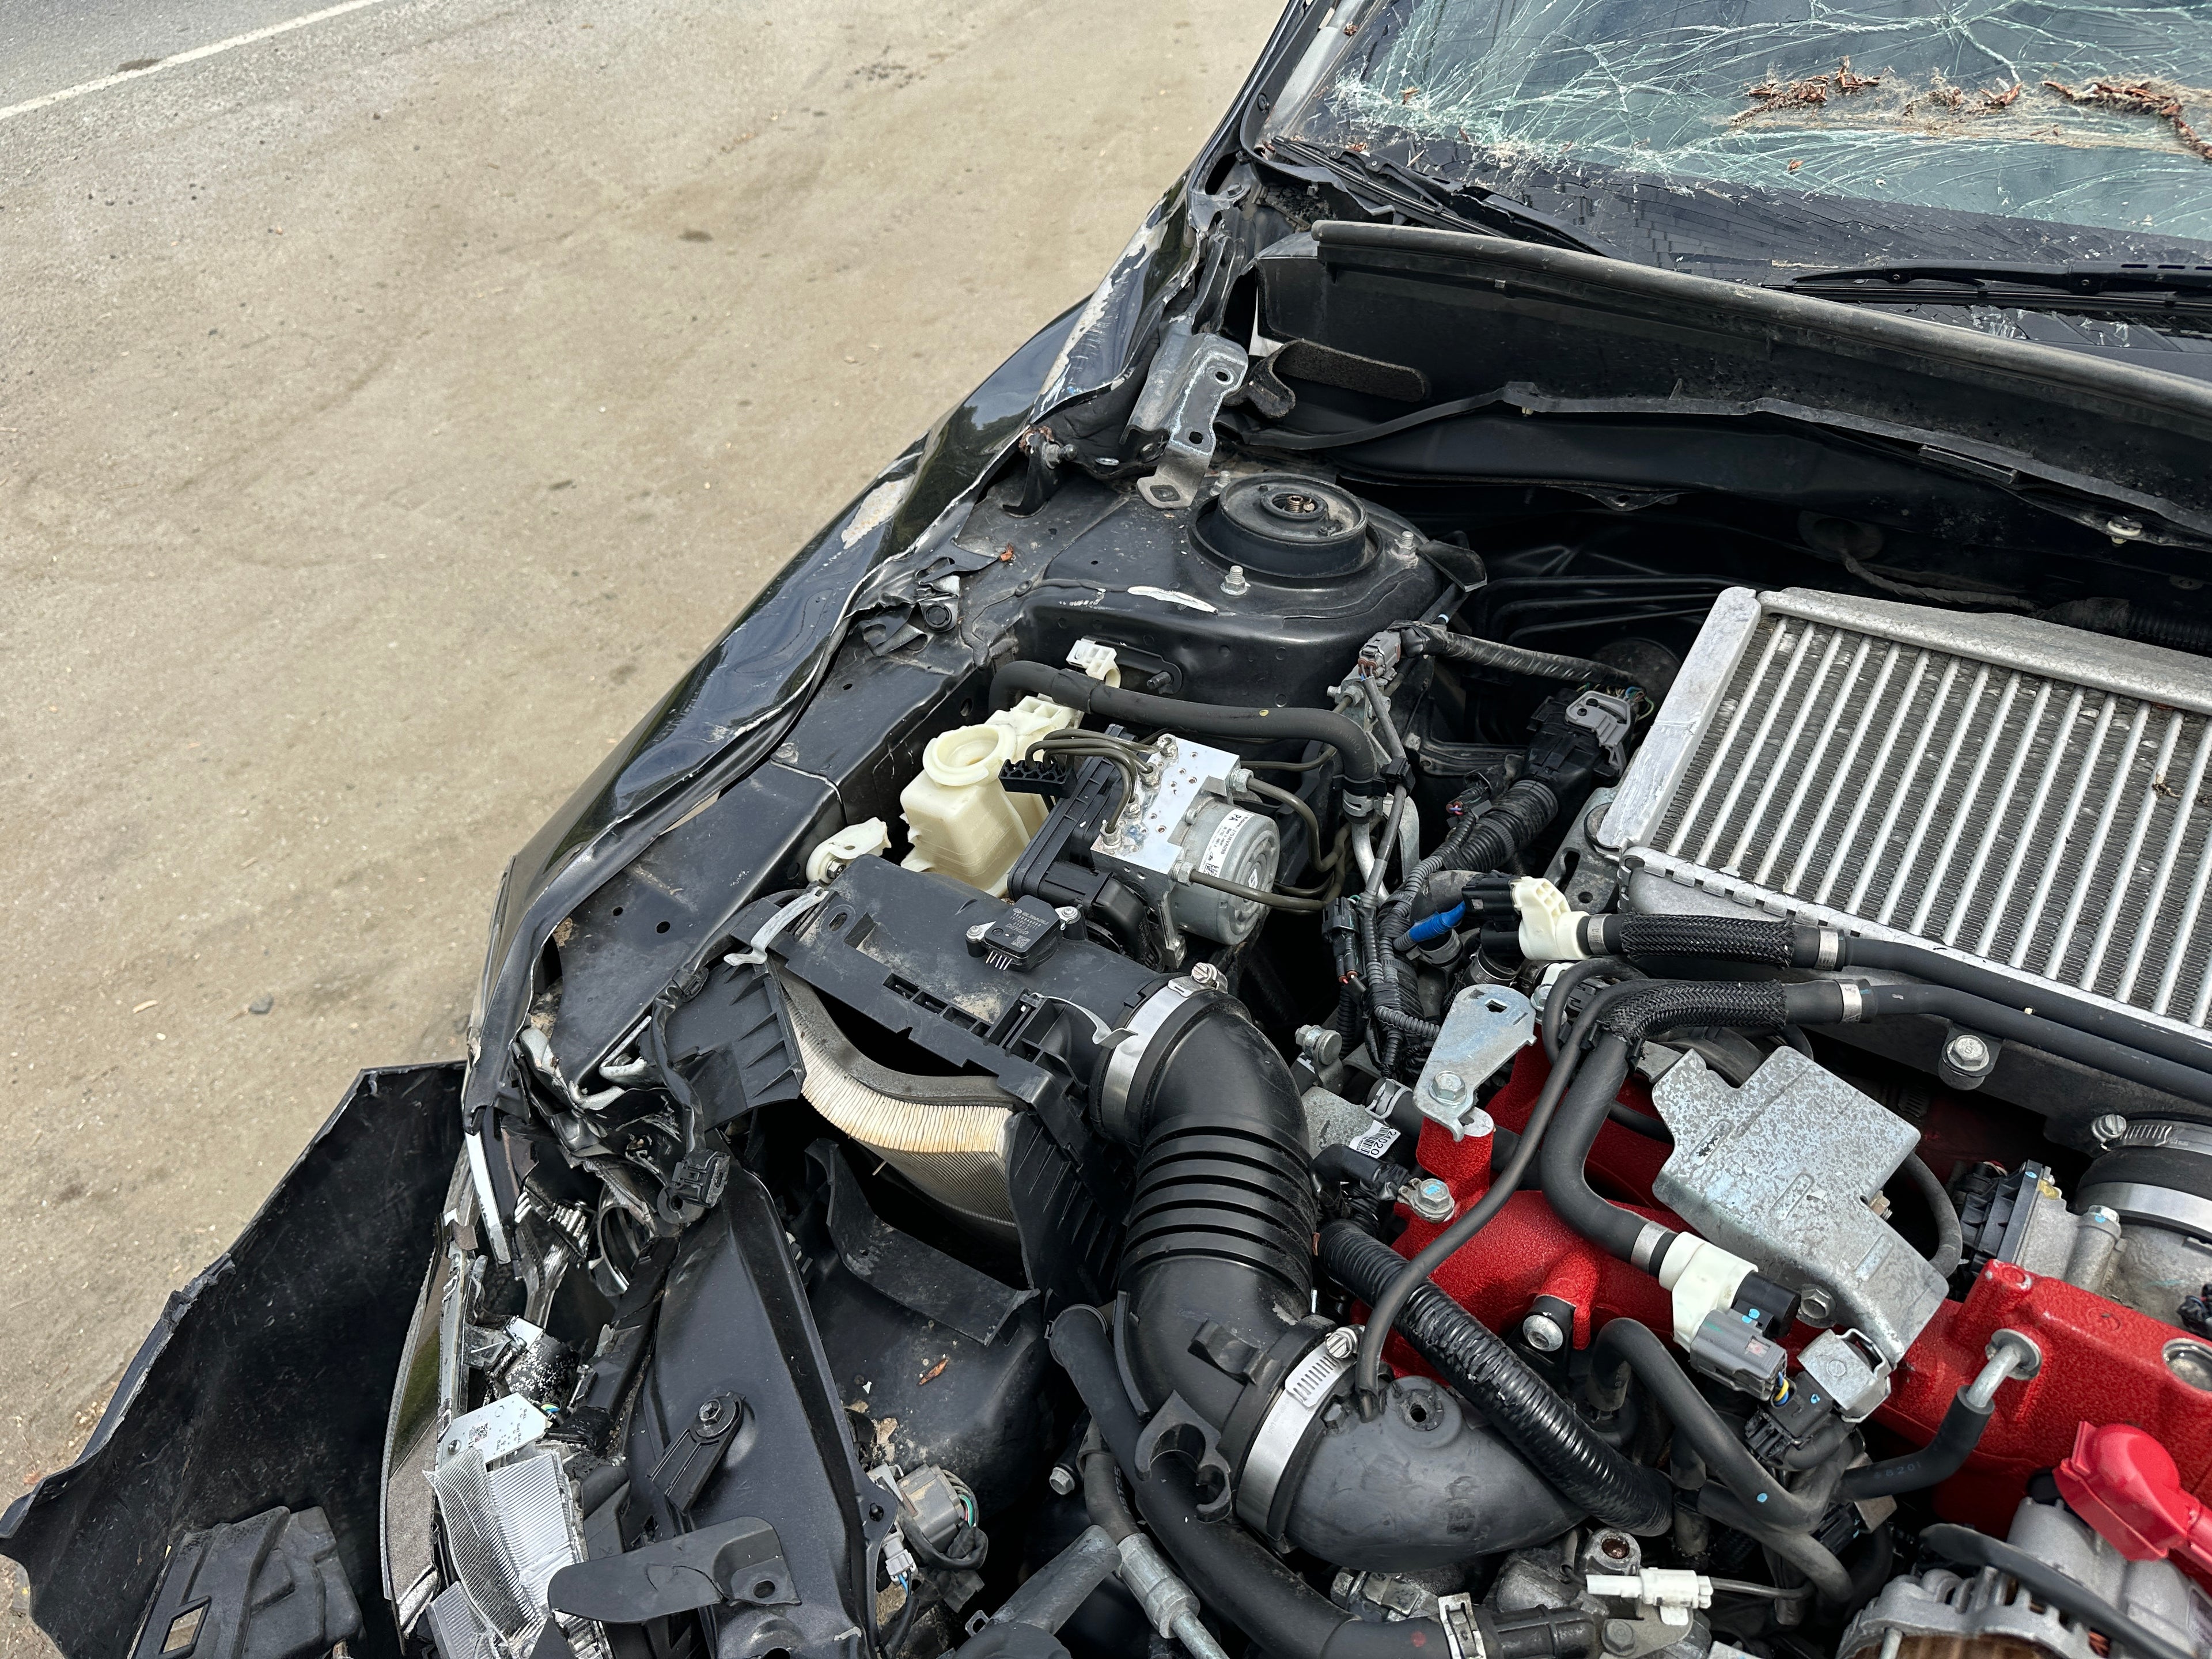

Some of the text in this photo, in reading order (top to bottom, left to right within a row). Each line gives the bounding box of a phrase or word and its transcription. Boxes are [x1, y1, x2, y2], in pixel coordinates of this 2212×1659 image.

[1022, 911, 1050, 925] SUBARU
[1005, 923, 1029, 935] DENSO
[1370, 1131, 1397, 1156] 24020
